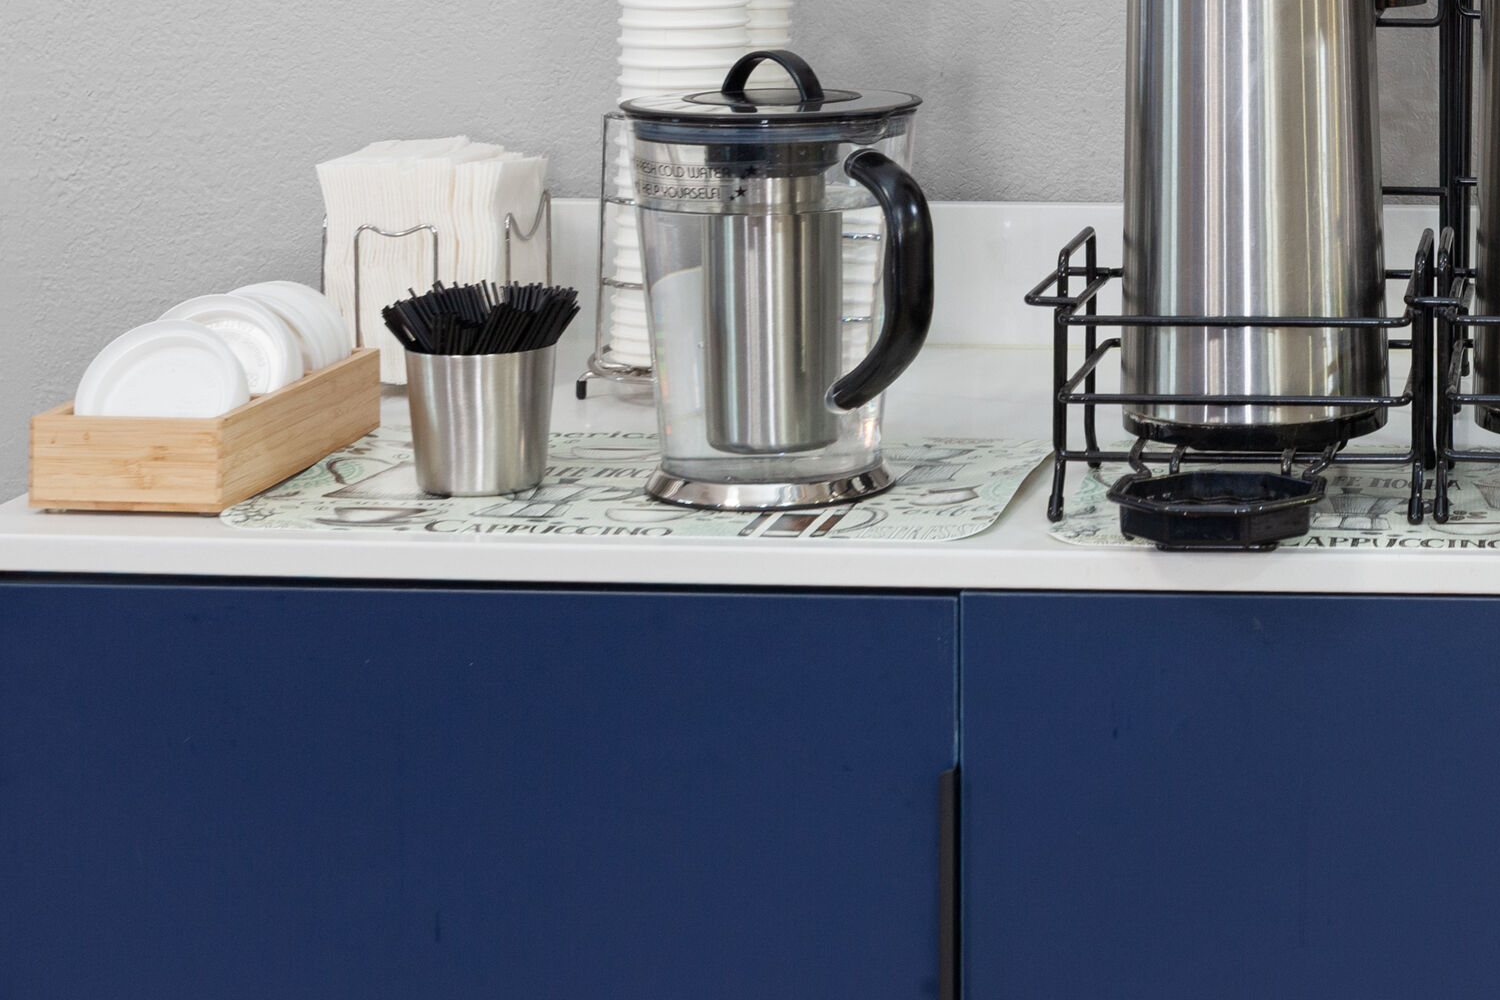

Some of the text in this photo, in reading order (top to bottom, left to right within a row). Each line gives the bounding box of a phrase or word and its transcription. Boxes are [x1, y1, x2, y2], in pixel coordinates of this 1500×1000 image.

[658, 165, 685, 177] COLD
[687, 167, 731, 179] WATER
[424, 518, 674, 537] CAPPUCCINO
